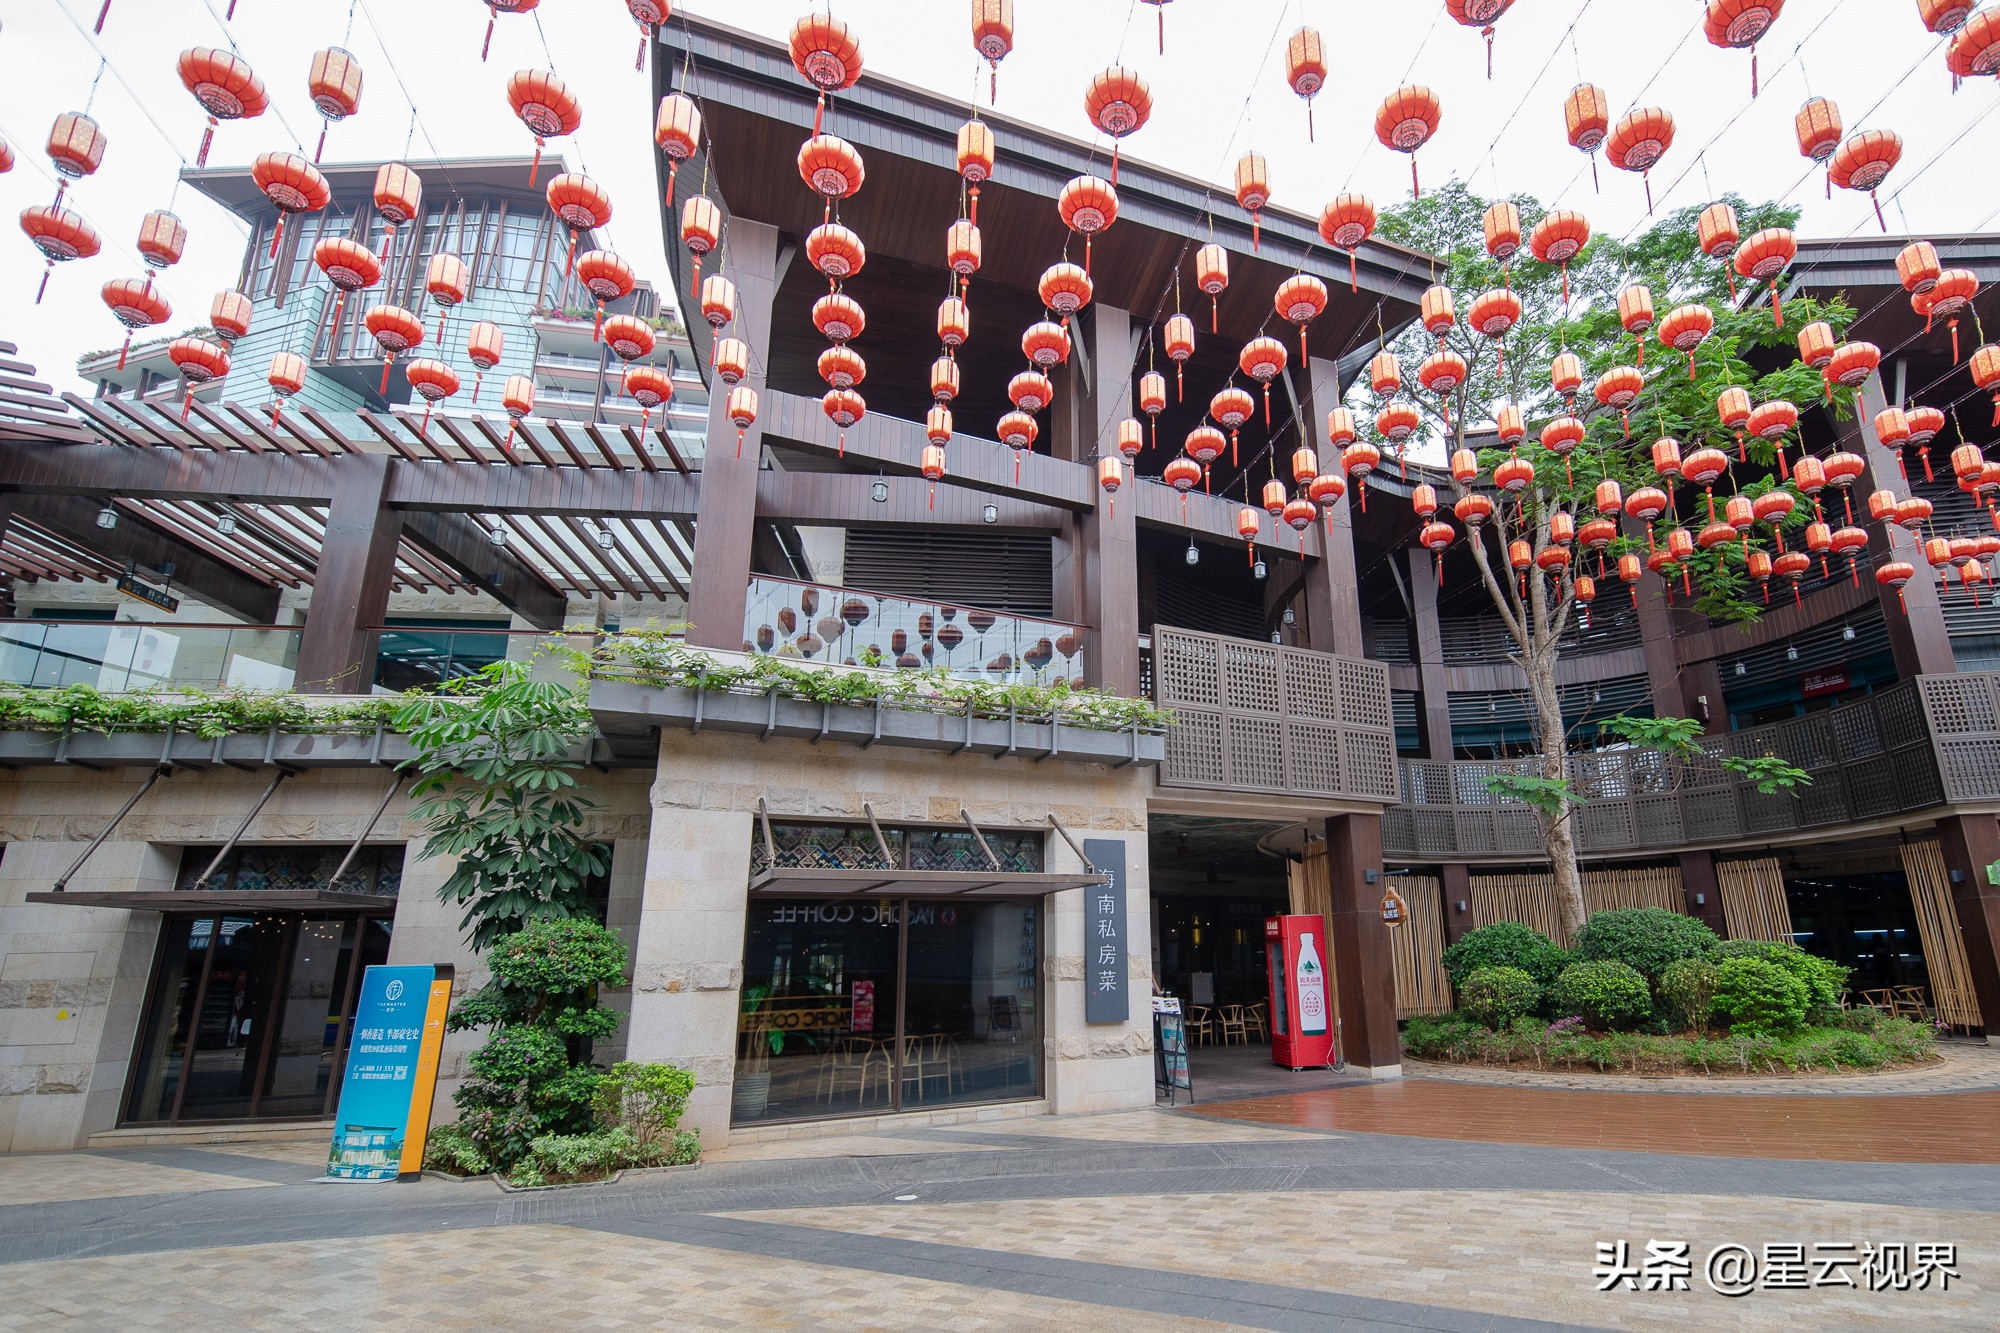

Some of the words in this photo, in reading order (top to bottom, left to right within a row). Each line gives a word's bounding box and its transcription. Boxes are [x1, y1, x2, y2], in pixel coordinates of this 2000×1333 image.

[1097, 868, 1116, 992] 海南私房菜
